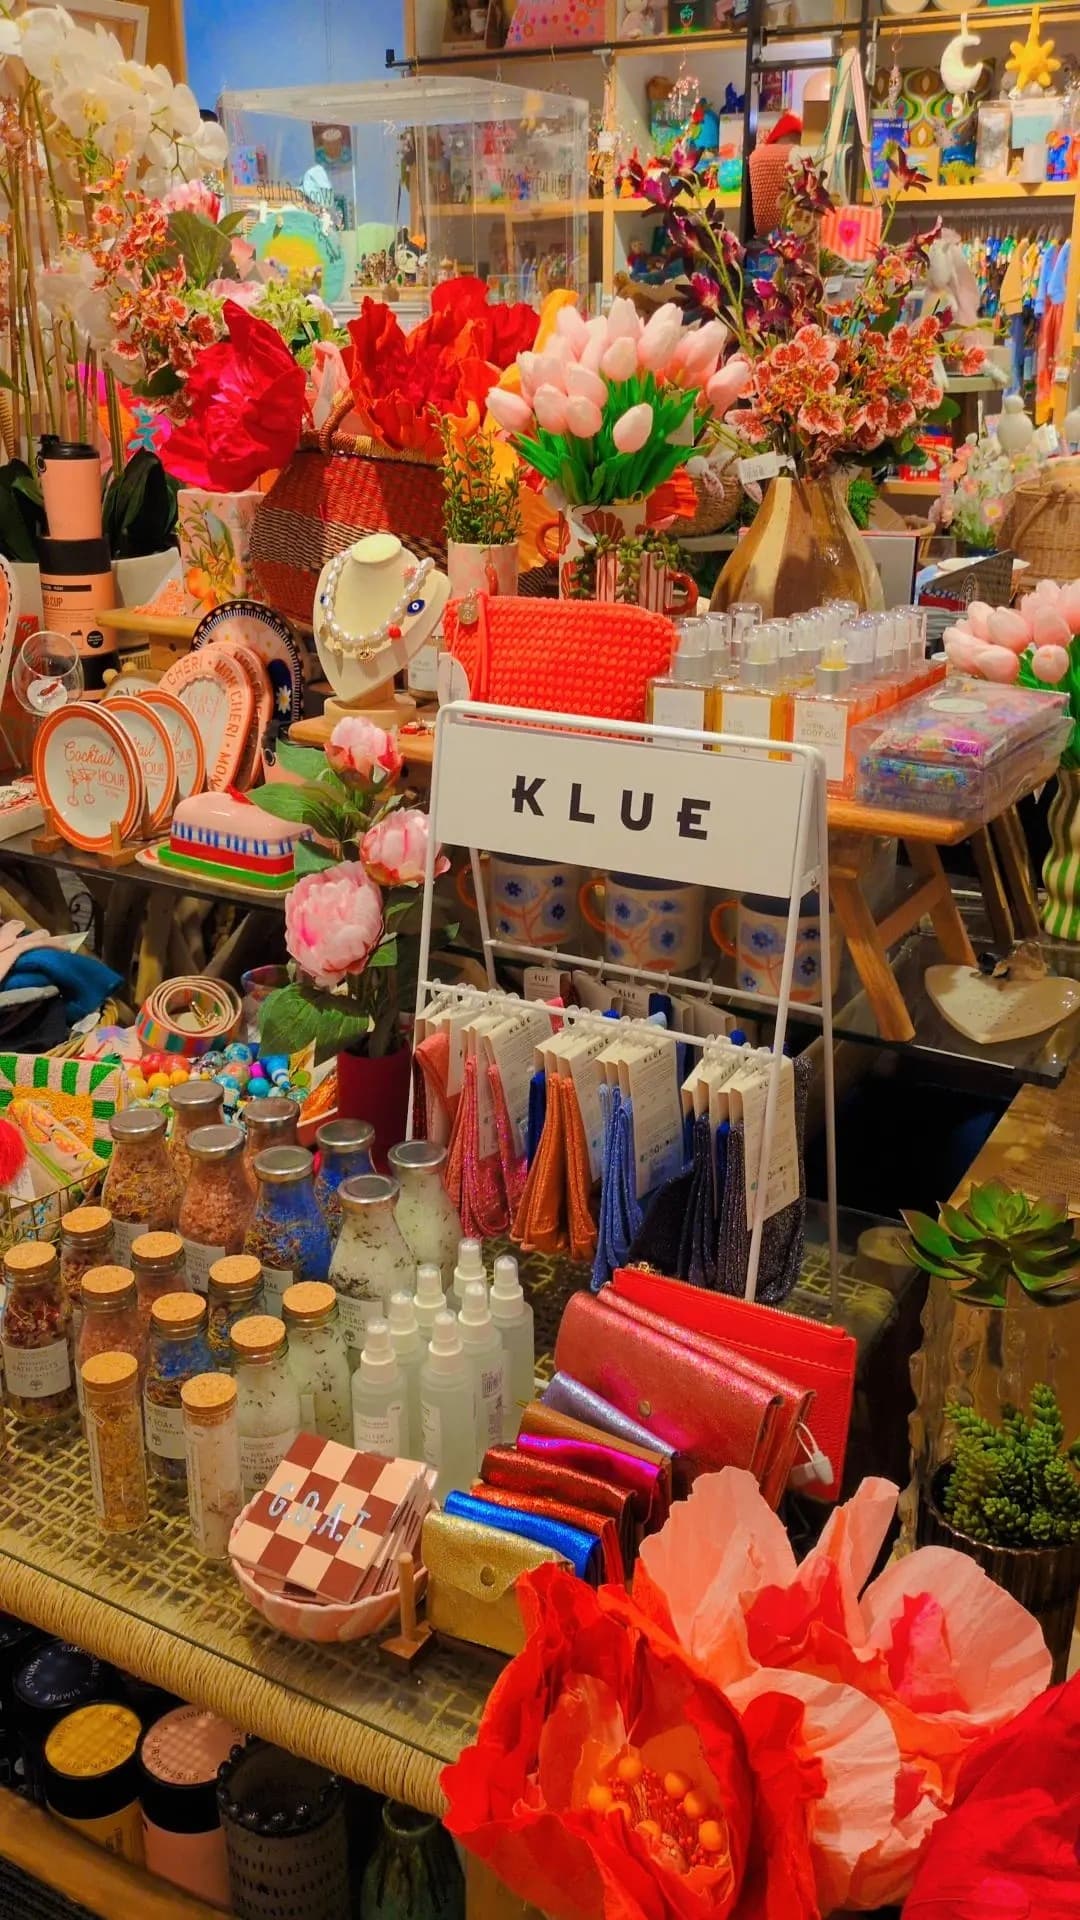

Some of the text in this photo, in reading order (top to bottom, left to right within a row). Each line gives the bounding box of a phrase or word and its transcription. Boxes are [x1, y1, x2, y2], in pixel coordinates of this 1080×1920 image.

[64, 741, 117, 766] Cocktail
[98, 768, 125, 786] HOUR
[512, 775, 711, 841] KLUE
[508, 1016, 531, 1035] KLUE
[587, 1038, 609, 1056] KLUE
[643, 1049, 663, 1063] KLUE
